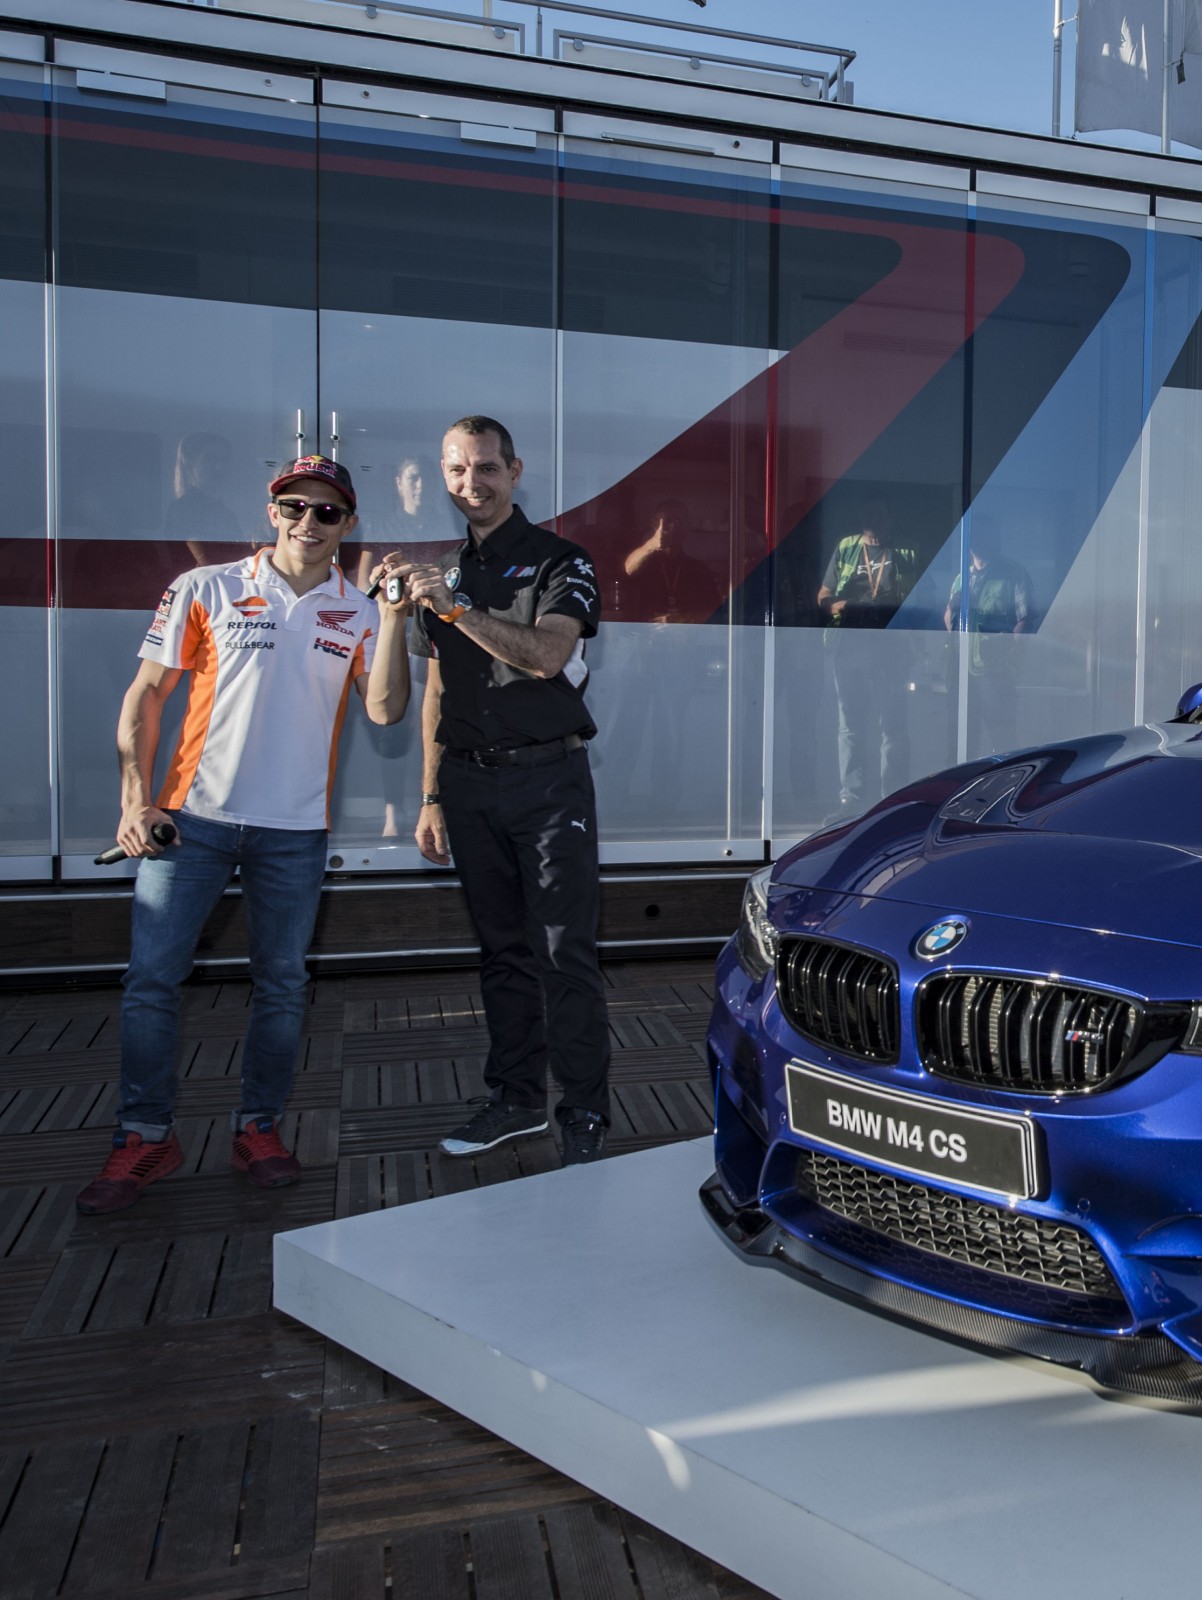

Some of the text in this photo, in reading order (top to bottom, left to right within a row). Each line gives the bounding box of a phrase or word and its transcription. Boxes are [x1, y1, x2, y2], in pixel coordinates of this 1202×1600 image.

[316, 621, 355, 637] HONDA
[225, 641, 275, 650] PULL&BEAR
[314, 638, 351, 659] HRC
[827, 1099, 967, 1163] BMW M4 CS
